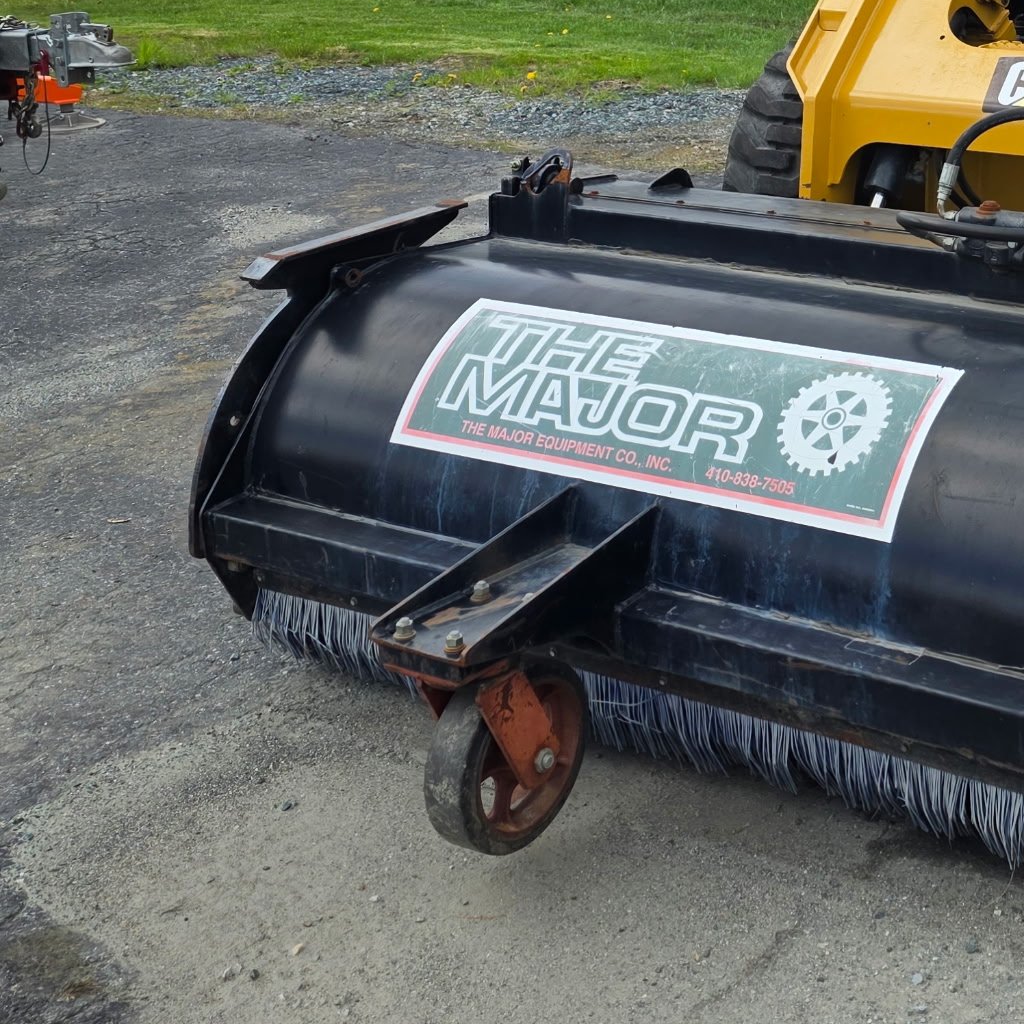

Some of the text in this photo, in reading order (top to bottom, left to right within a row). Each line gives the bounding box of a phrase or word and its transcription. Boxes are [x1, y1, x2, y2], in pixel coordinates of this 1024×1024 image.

[488, 313, 666, 383] THE
[436, 352, 765, 465] MAJOR
[461, 419, 486, 438] THE
[487, 424, 533, 447] MAJOR
[535, 434, 614, 464] EQUIPMENT
[645, 455, 672, 473] INC.
[705, 466, 796, 496] 410-838-7505
